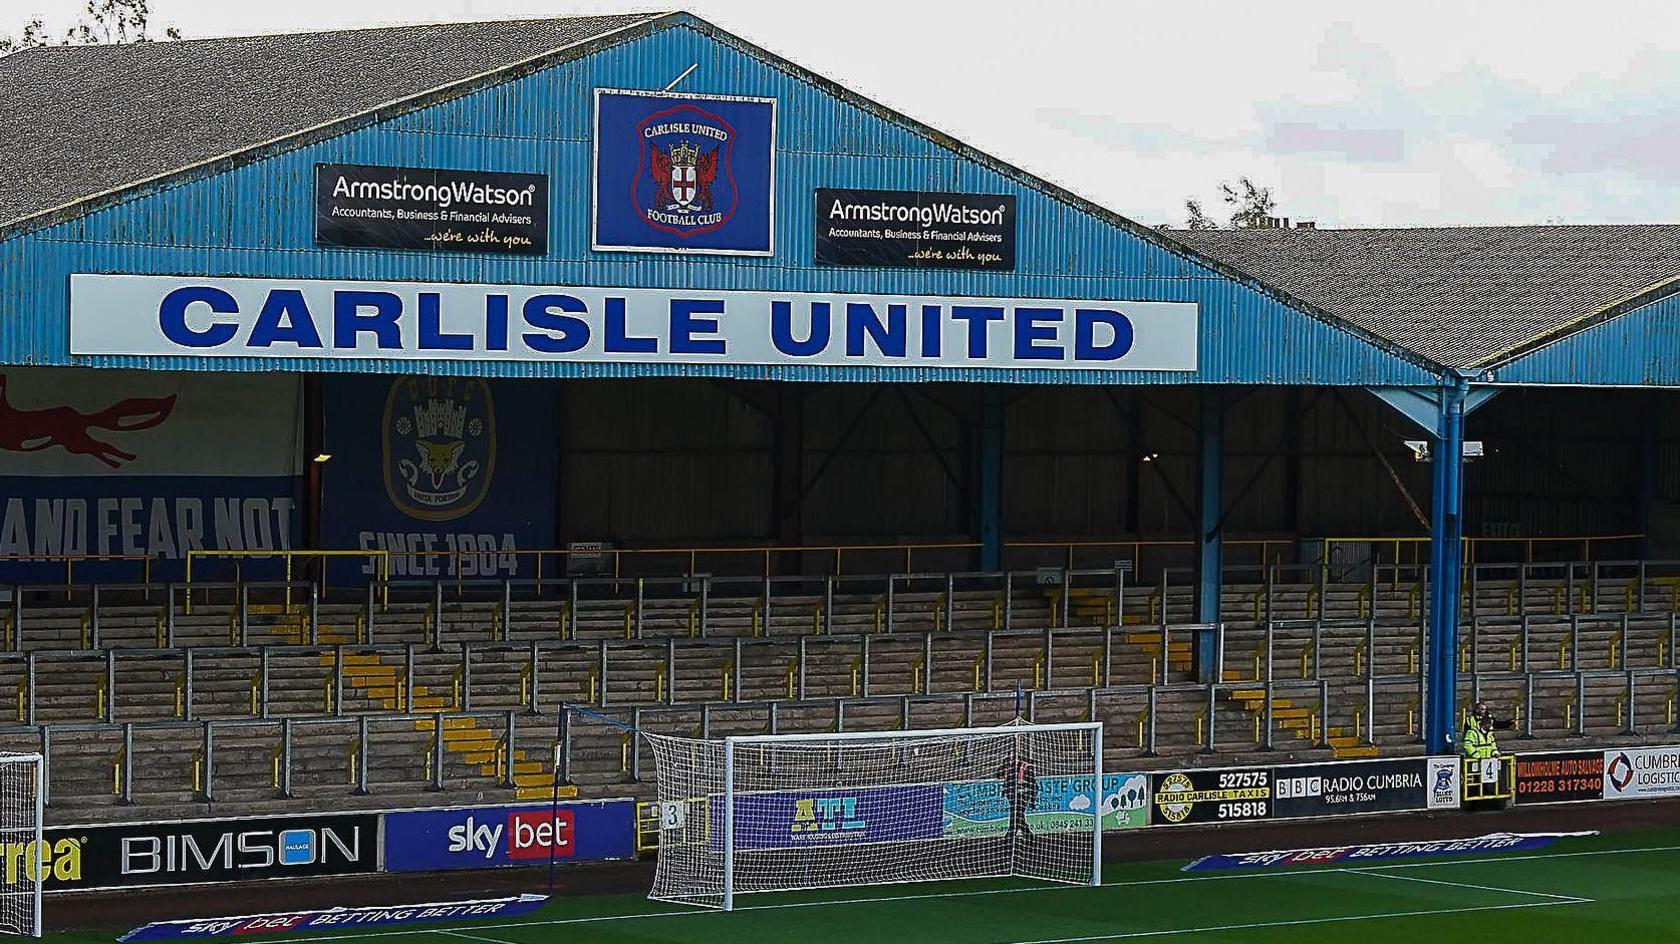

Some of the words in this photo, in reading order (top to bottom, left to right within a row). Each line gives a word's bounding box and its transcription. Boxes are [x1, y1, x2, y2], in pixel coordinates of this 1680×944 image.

[644, 123, 690, 139] CARLISLE
[692, 124, 728, 141] UNITED
[331, 206, 395, 220] Accountants,
[397, 208, 439, 220] Business
[440, 211, 448, 221] &
[450, 211, 490, 223] Financial
[491, 213, 532, 225] Advisers
[647, 209, 696, 226] FOOTBALL
[697, 212, 722, 225] CLUB
[467, 228, 500, 243] with
[503, 234, 532, 248] you
[829, 228, 883, 240] Accountants,
[885, 229, 921, 240] Business
[923, 231, 930, 240] &
[931, 231, 967, 241] Financial
[967, 232, 1002, 242] Advisers
[946, 246, 975, 261] with
[977, 252, 1002, 265] you
[159, 286, 726, 357] CARLISLE
[771, 300, 1133, 369] UNITED
[0, 498, 87, 561] AND
[98, 498, 206, 560] FEAR
[214, 497, 296, 559] NOT
[359, 531, 440, 576] SINCE
[445, 533, 519, 577] 1904
[1485, 761, 1494, 779] 4
[1561, 760, 1577, 776] AUTO
[1578, 759, 1604, 775] SALVAGE
[1036, 778, 1069, 794] ASTE
[1162, 774, 1191, 790] 527575
[1218, 772, 1267, 788] 527575
[1323, 777, 1363, 793] RADIO
[1366, 773, 1422, 790] CUMBRIA
[1519, 780, 1555, 793] 01228
[1558, 778, 1602, 791] 317340
[1158, 792, 1184, 803] RADIO
[1186, 790, 1228, 802] CARLISLE
[1231, 788, 1267, 799] TAXIS
[1349, 794, 1355, 803] &
[667, 804, 677, 826] 3
[1217, 802, 1267, 819] 515818
[448, 816, 503, 858] sky
[514, 816, 568, 848] bet
[121, 826, 360, 875] BIMSON
[1239, 851, 1294, 867] sky
[1292, 847, 1348, 863] bet
[1349, 843, 1444, 859] BETTING
[1445, 836, 1523, 851] BETTER
[181, 919, 245, 935] sky
[244, 914, 306, 930] bet
[309, 908, 414, 926] BETTING
[416, 902, 507, 920] BETTER
